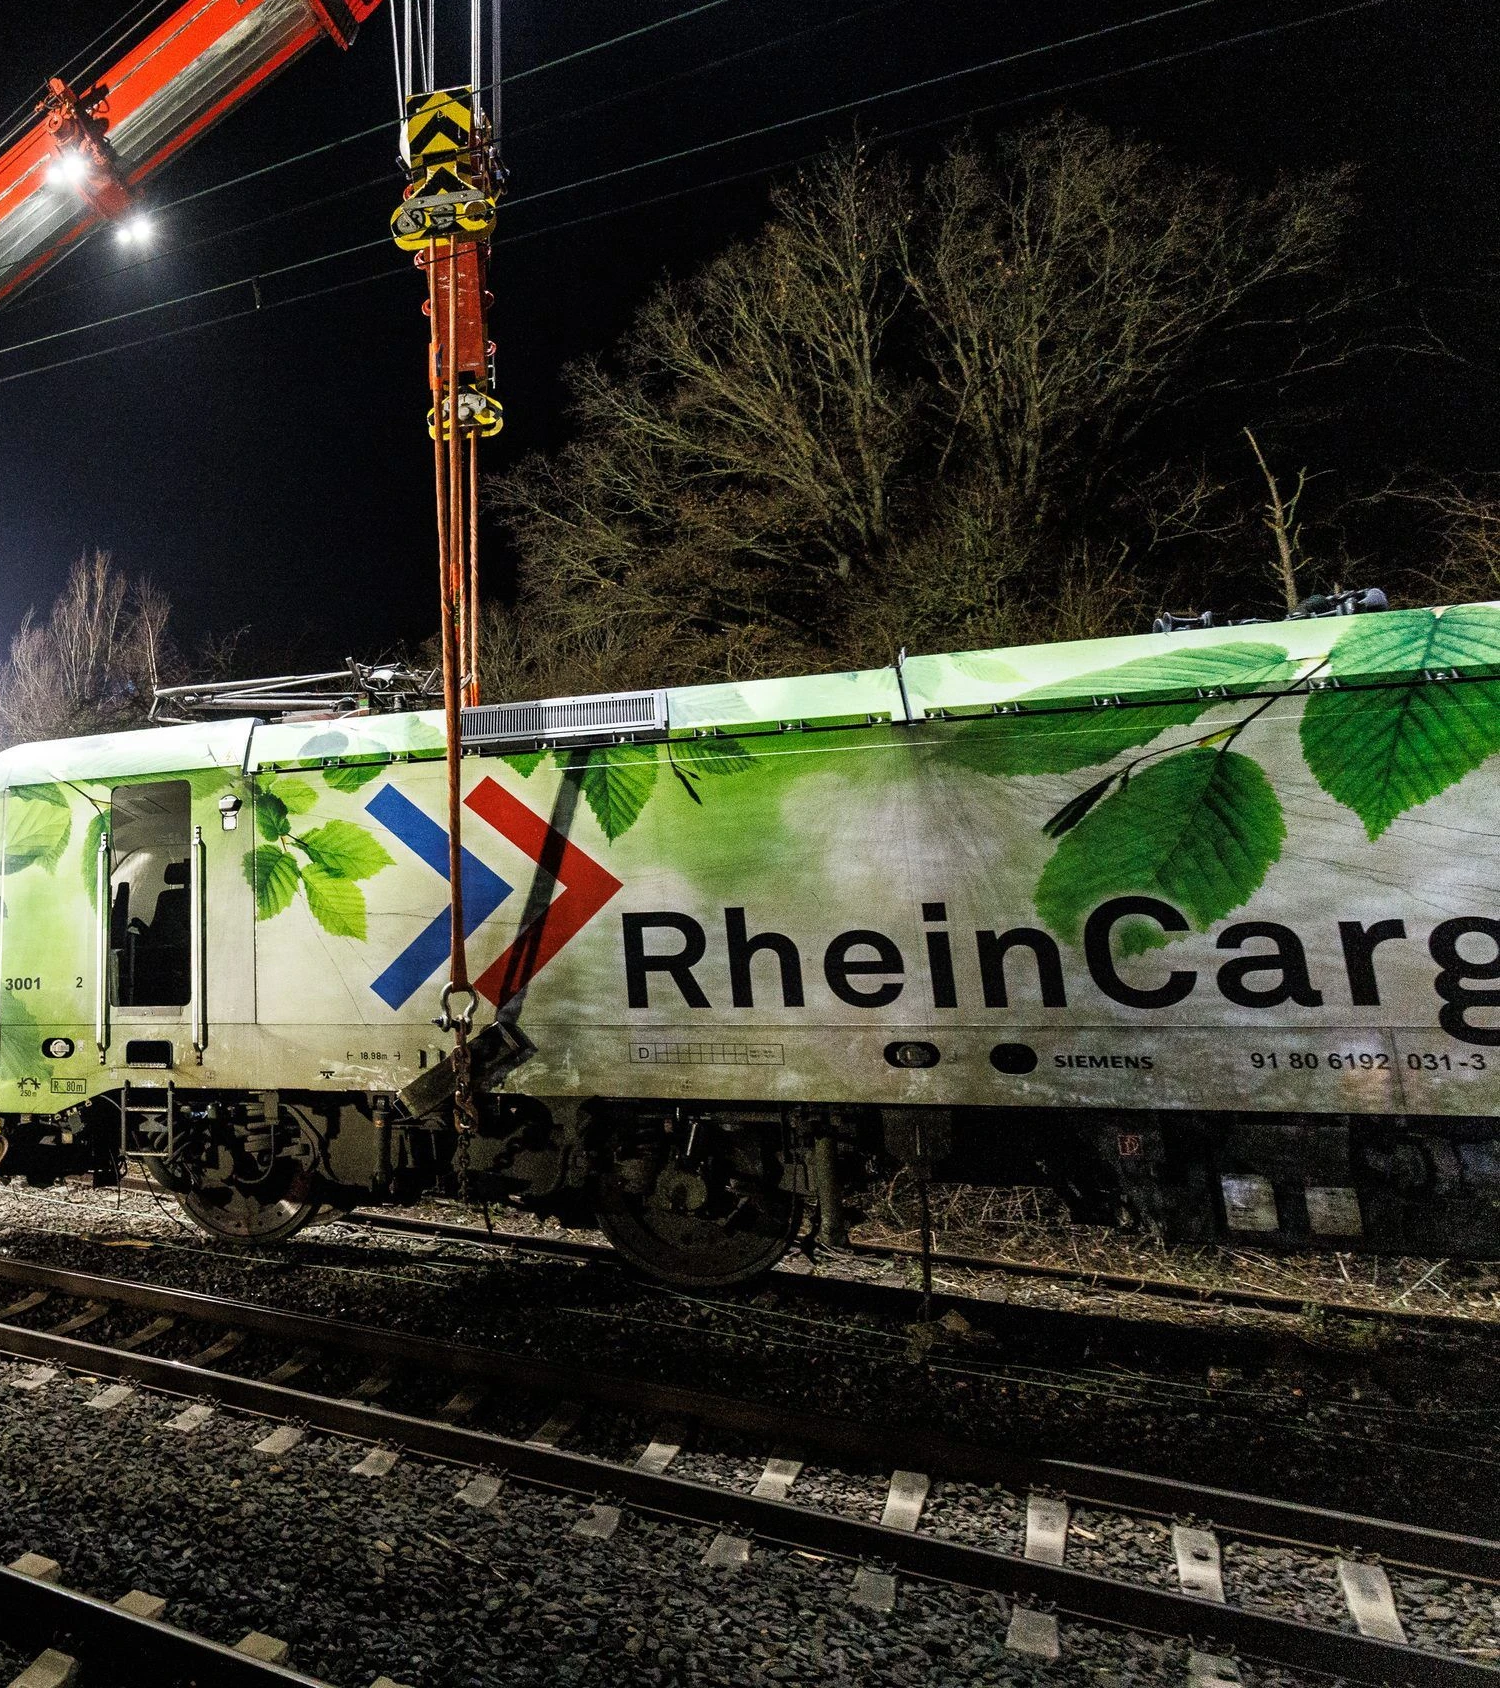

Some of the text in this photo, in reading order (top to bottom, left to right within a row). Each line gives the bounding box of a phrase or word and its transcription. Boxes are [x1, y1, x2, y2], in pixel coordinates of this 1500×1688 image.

[5, 976, 83, 991] 3001 2
[638, 1047, 650, 1059] D
[1053, 1053, 1154, 1070] SIEMENS
[1250, 1052, 1279, 1070] 91
[1288, 1052, 1319, 1070] 80
[1328, 1052, 1390, 1071] 6192
[53, 1081, 60, 1091] R
